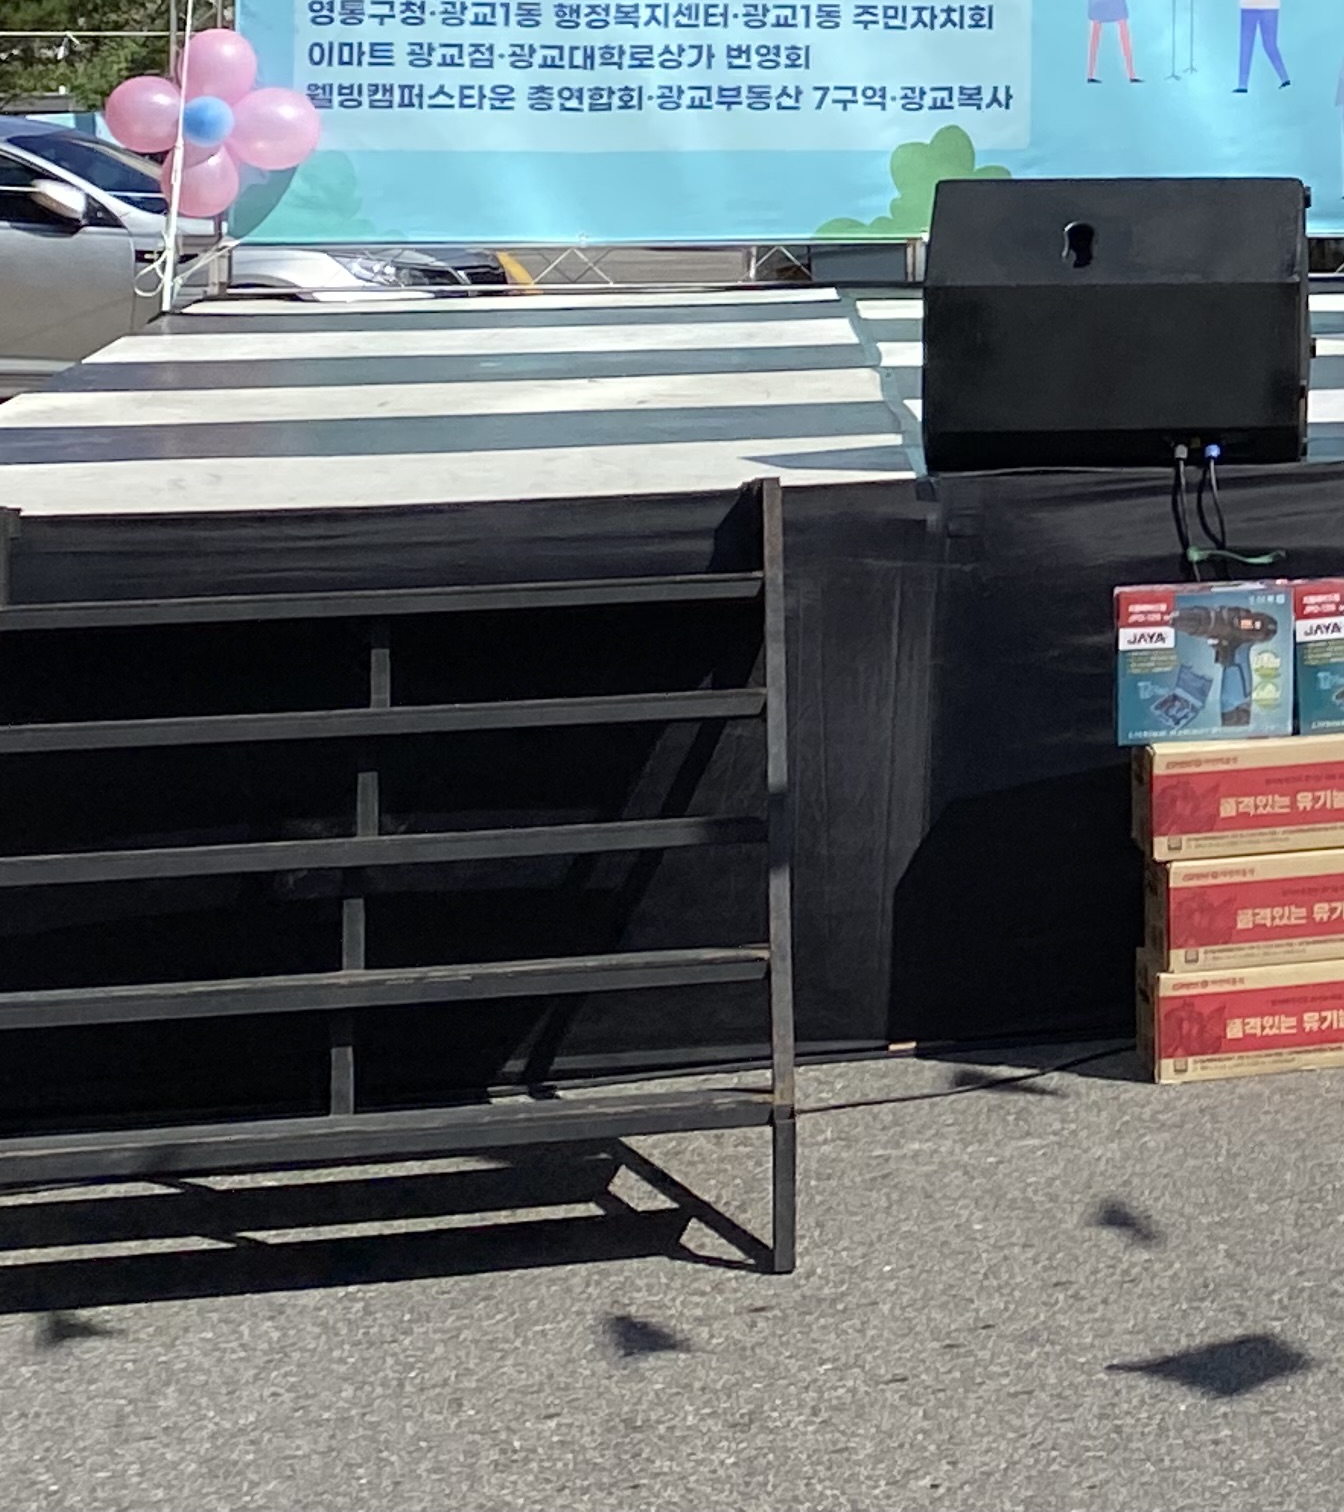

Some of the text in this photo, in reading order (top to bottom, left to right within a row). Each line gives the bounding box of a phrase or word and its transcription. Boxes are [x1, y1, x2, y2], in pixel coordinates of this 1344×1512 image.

[852, 3, 995, 31] 주민자치회
[308, 41, 395, 68] 이마트
[726, 43, 811, 71] 번영회
[306, 82, 516, 111] 웰빙캠퍼스타운
[1127, 632, 1167, 645] JAYA
[1304, 622, 1342, 637] JAYA
